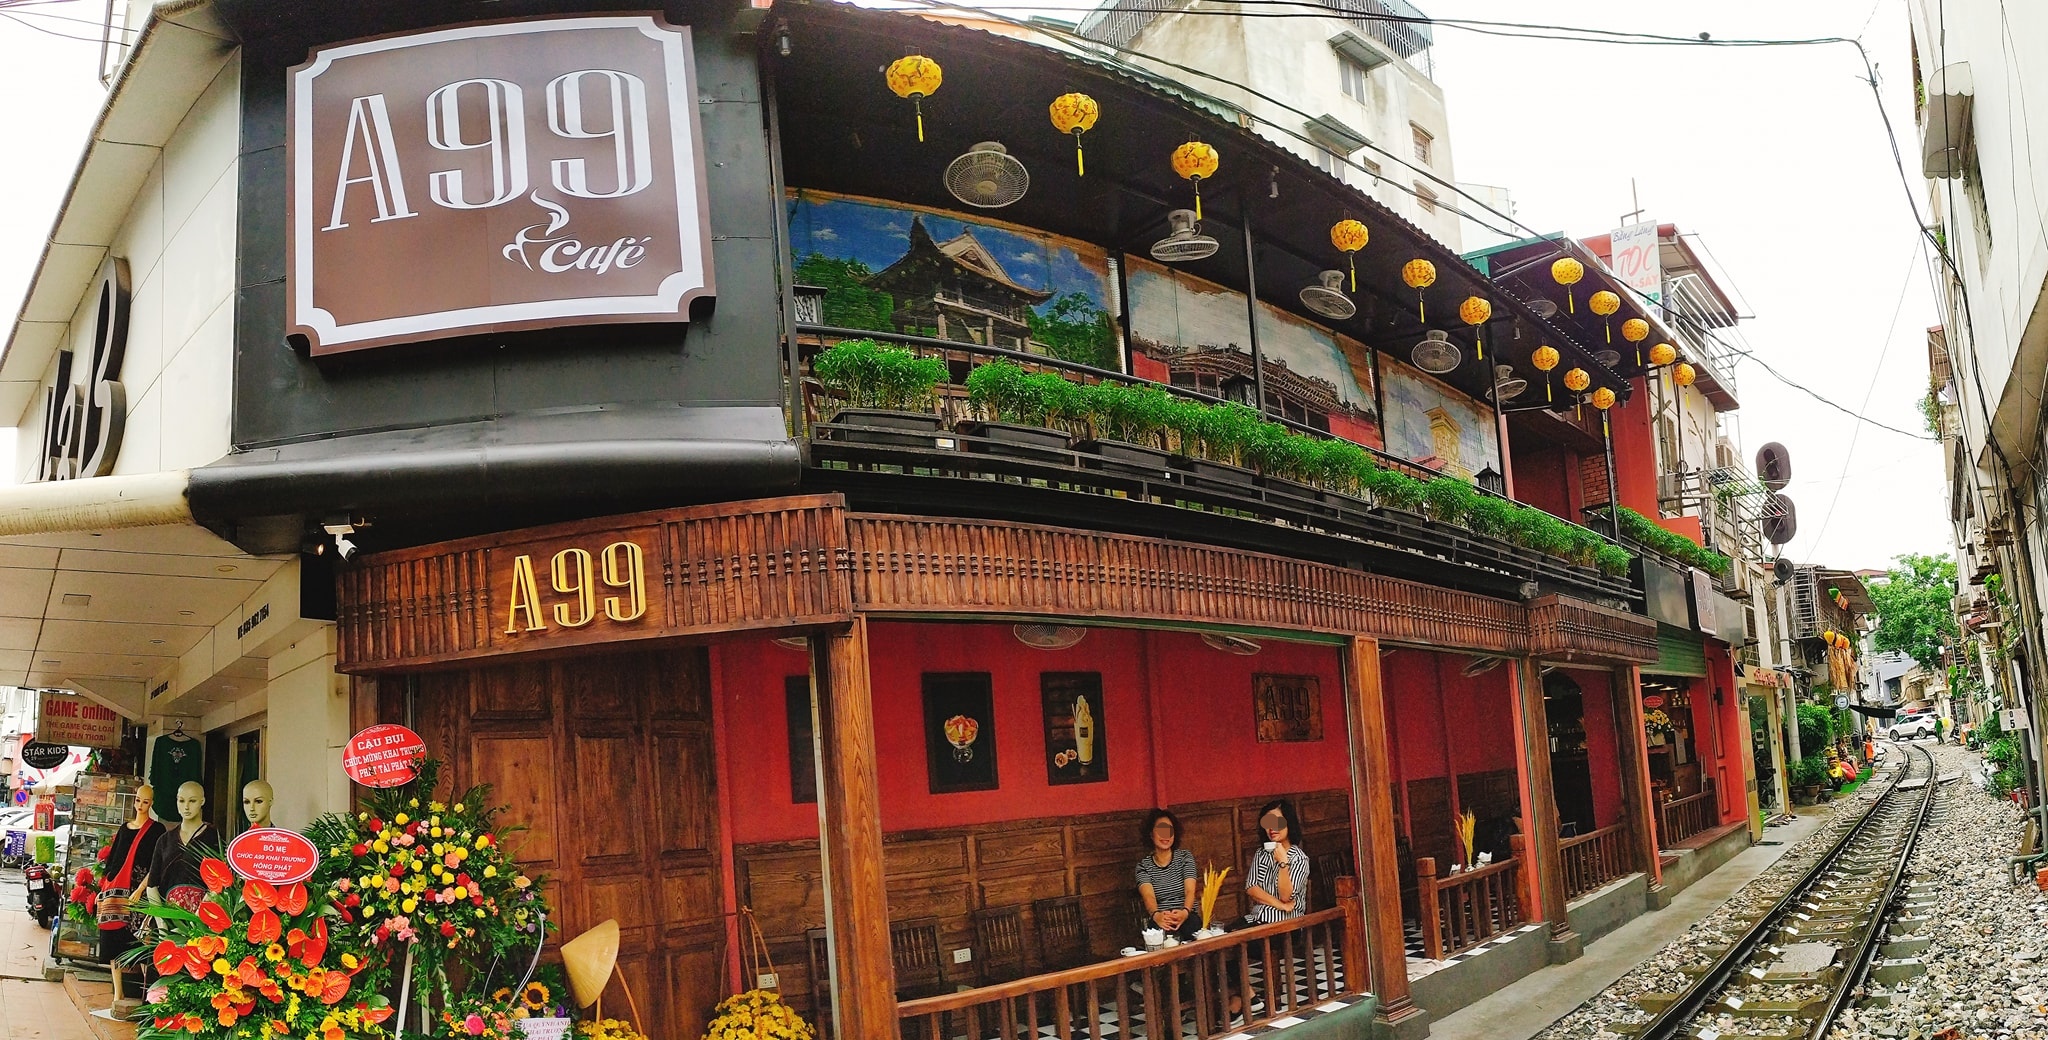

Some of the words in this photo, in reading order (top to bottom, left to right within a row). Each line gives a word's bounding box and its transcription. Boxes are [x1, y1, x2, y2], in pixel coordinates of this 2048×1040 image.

[321, 69, 653, 232] A99
[540, 236, 652, 275] Café
[504, 541, 647, 635] A99
[46, 699, 79, 718] GAME
[82, 704, 117, 722] online
[1263, 686, 1311, 721] A99
[2010, 720, 2016, 729] 5
[384, 733, 405, 744] BỤI
[47, 746, 67, 755] KIDS
[344, 755, 363, 768] CHÚC
[363, 750, 382, 764] MỪNG
[382, 748, 399, 759] KHAI
[378, 762, 391, 774] TÀI
[5, 836, 12, 848] P
